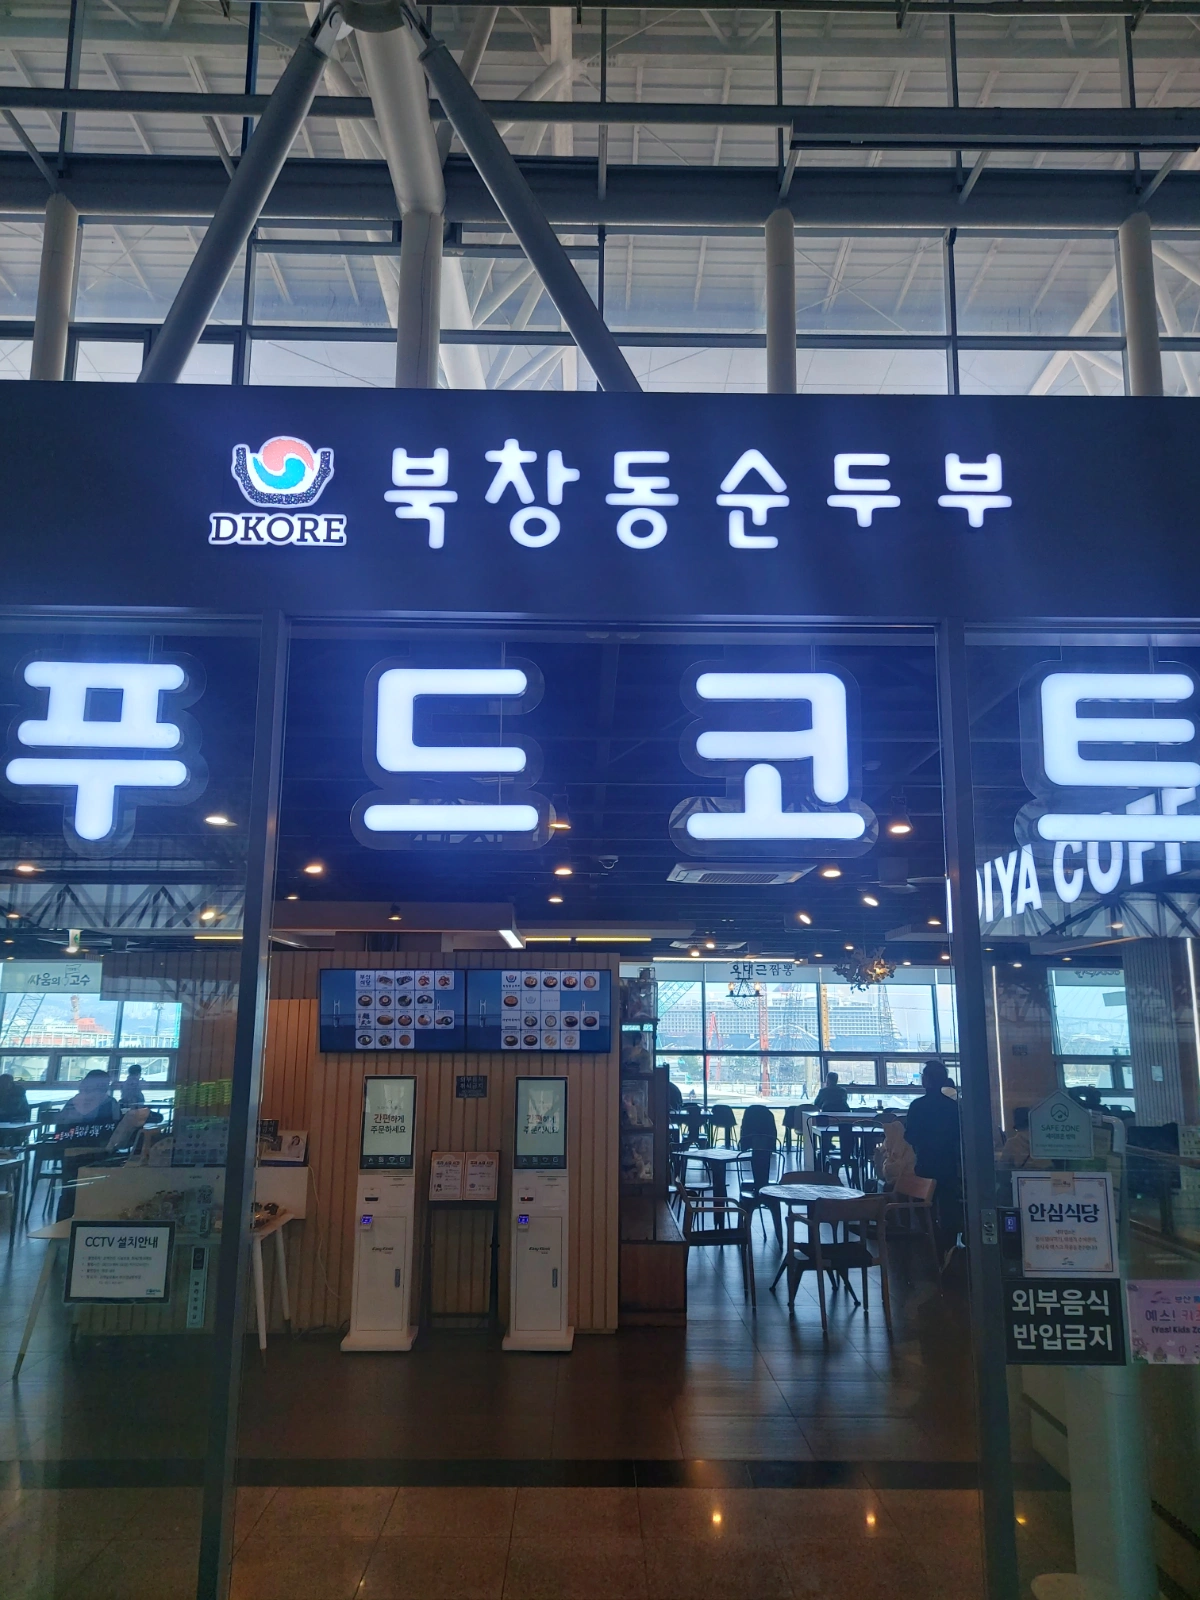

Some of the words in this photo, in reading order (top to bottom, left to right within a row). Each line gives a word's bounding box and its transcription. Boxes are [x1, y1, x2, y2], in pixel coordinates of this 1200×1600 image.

[384, 438, 1013, 550] 북창동순두부
[208, 512, 348, 546] DKORE
[5, 661, 1200, 841] 푸드코트
[976, 842, 1043, 923] IYA
[27, 972, 61, 987] 싸움의
[69, 974, 91, 987] 고수
[373, 1113, 405, 1124] 간편하게
[370, 1125, 406, 1134] 주문하세요
[1041, 1124, 1060, 1132] SAFE
[1060, 1124, 1081, 1132] ZONE
[1028, 1203, 1100, 1223] 안심식당
[84, 1236, 115, 1248] CCTV
[117, 1236, 159, 1249] 설치안내
[1011, 1288, 1110, 1317] 외부음식
[1174, 1295, 1192, 1304] 부산
[1145, 1309, 1176, 1322] 예스!
[1013, 1323, 1113, 1351] 반입금지
[1172, 1325, 1191, 1334] Kids
